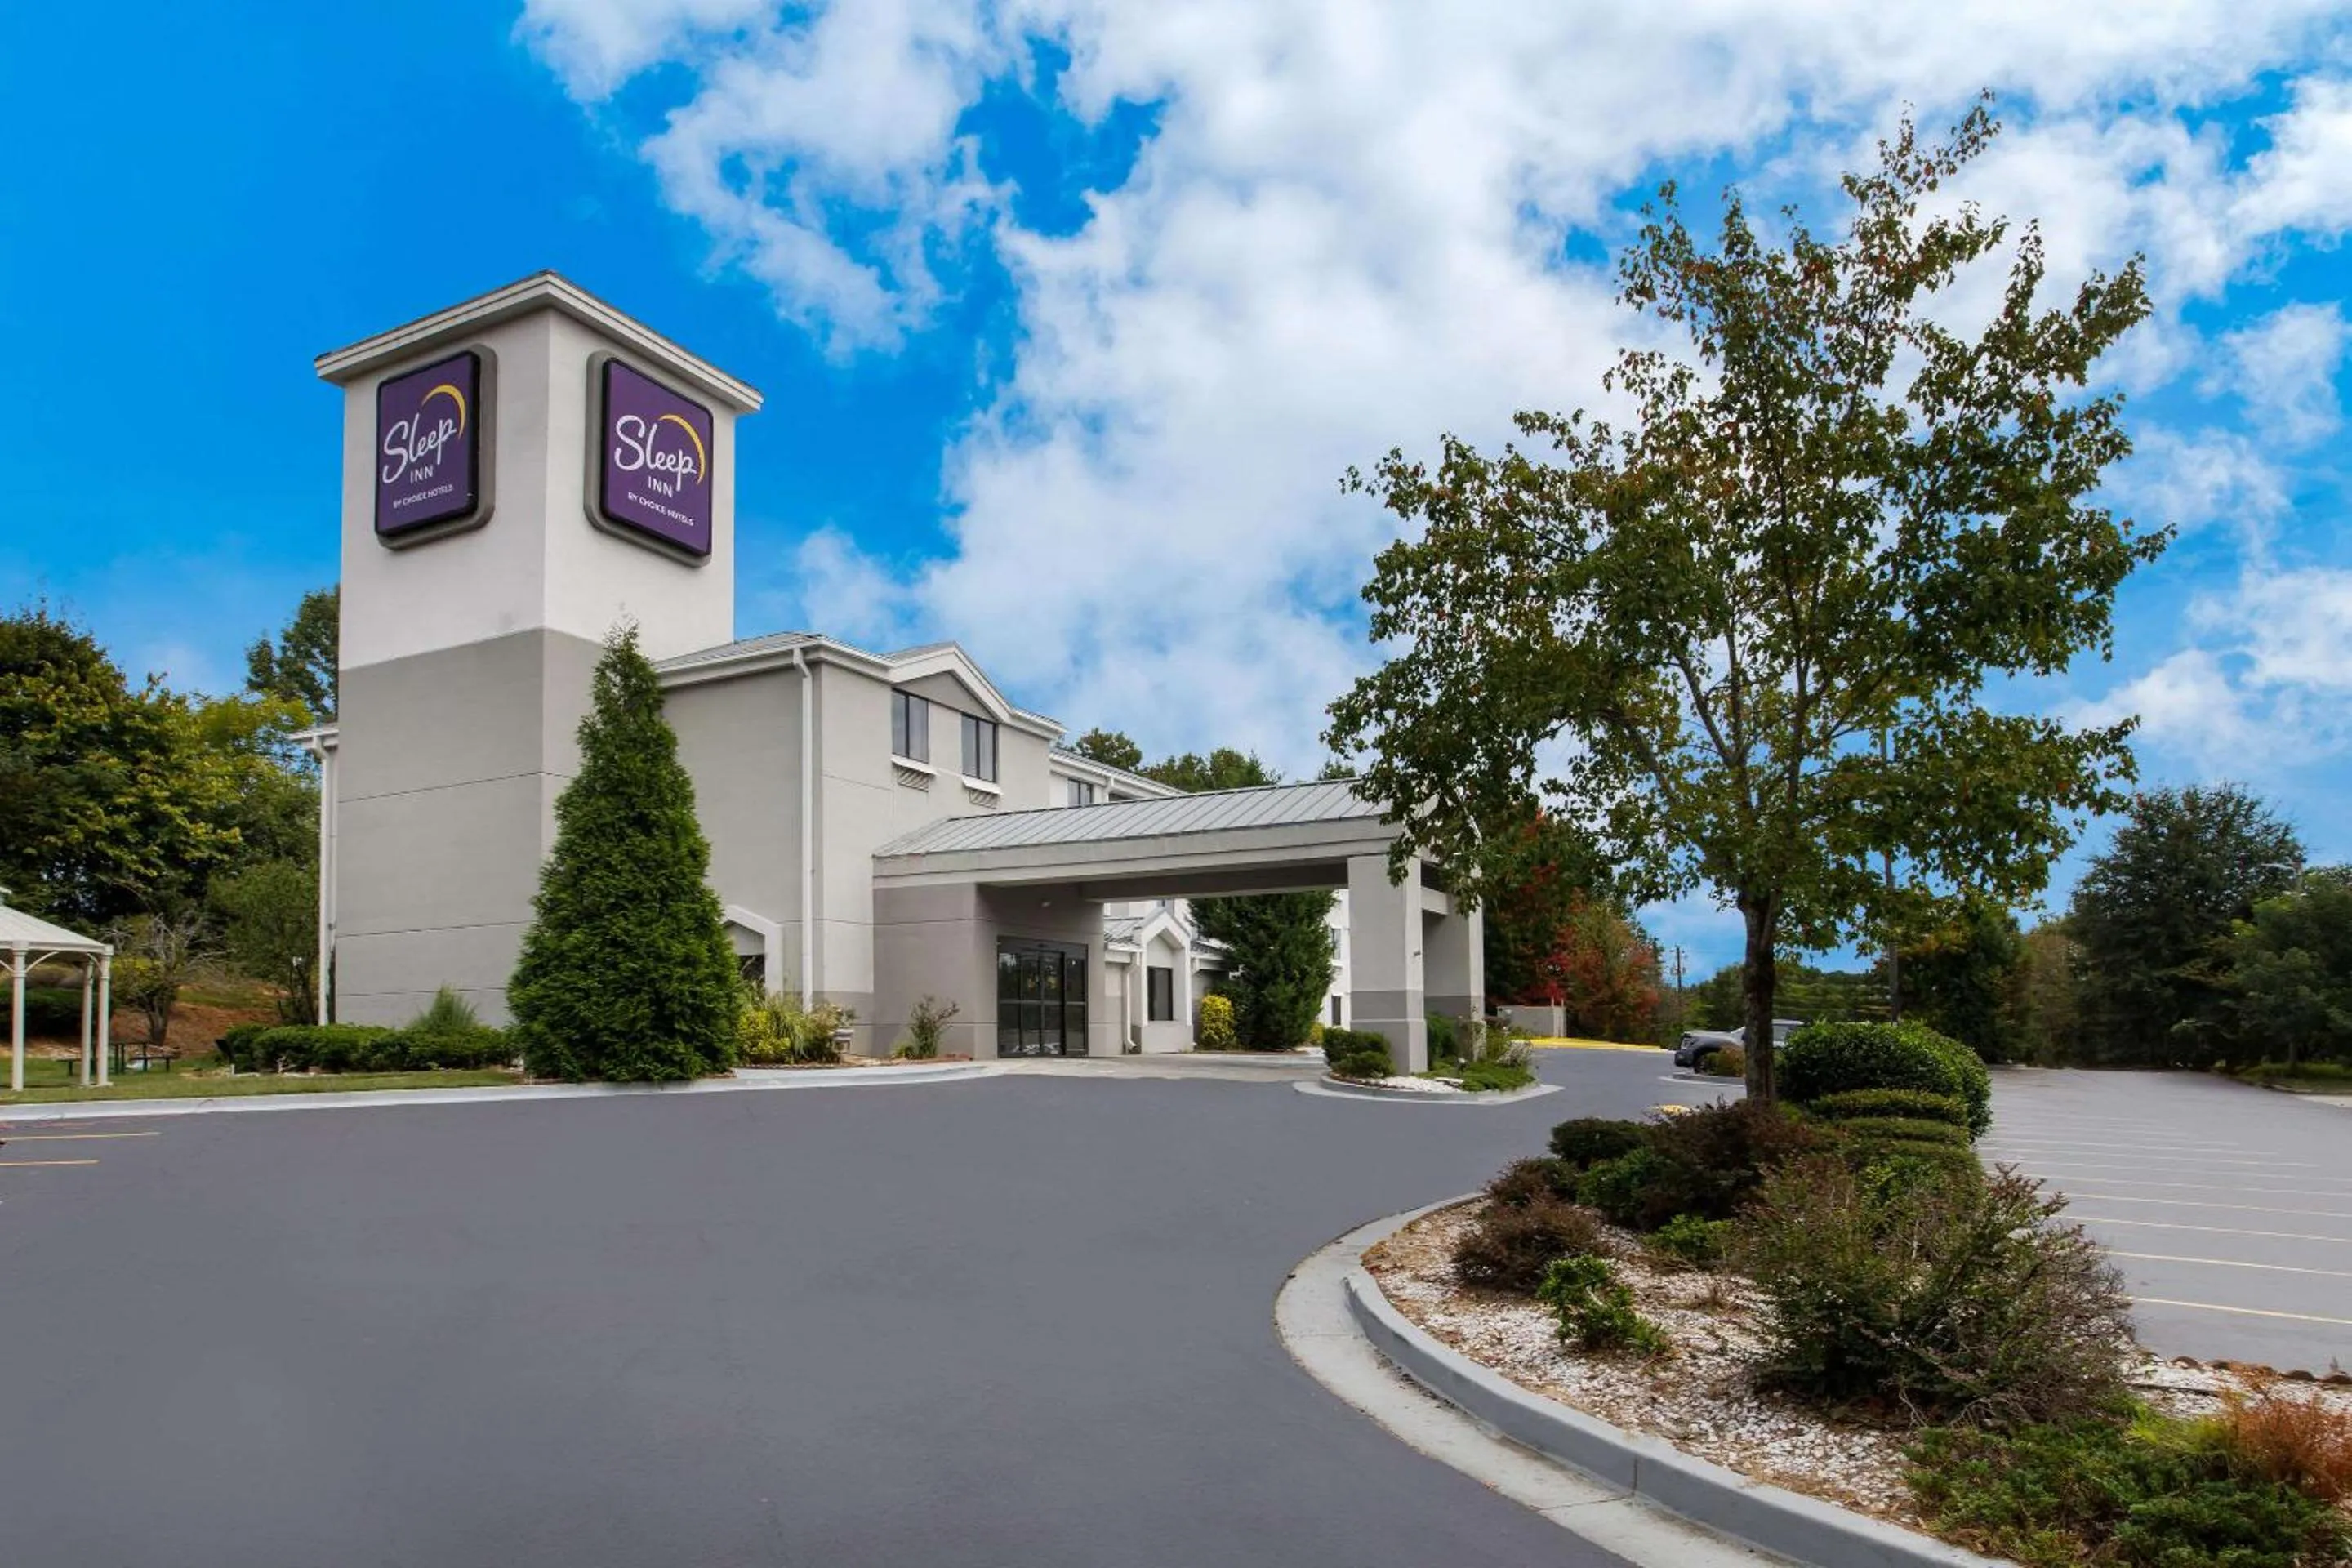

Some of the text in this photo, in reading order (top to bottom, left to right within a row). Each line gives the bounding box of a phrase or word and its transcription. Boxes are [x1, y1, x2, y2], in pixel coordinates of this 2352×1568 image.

[382, 412, 457, 484] Sleep
[614, 414, 698, 492] Sleep
[410, 464, 434, 484] INN
[648, 475, 674, 498] INN
[393, 483, 454, 509] BY CHOICE HOTELS
[628, 491, 695, 527] BY CHOICE HOTELS
